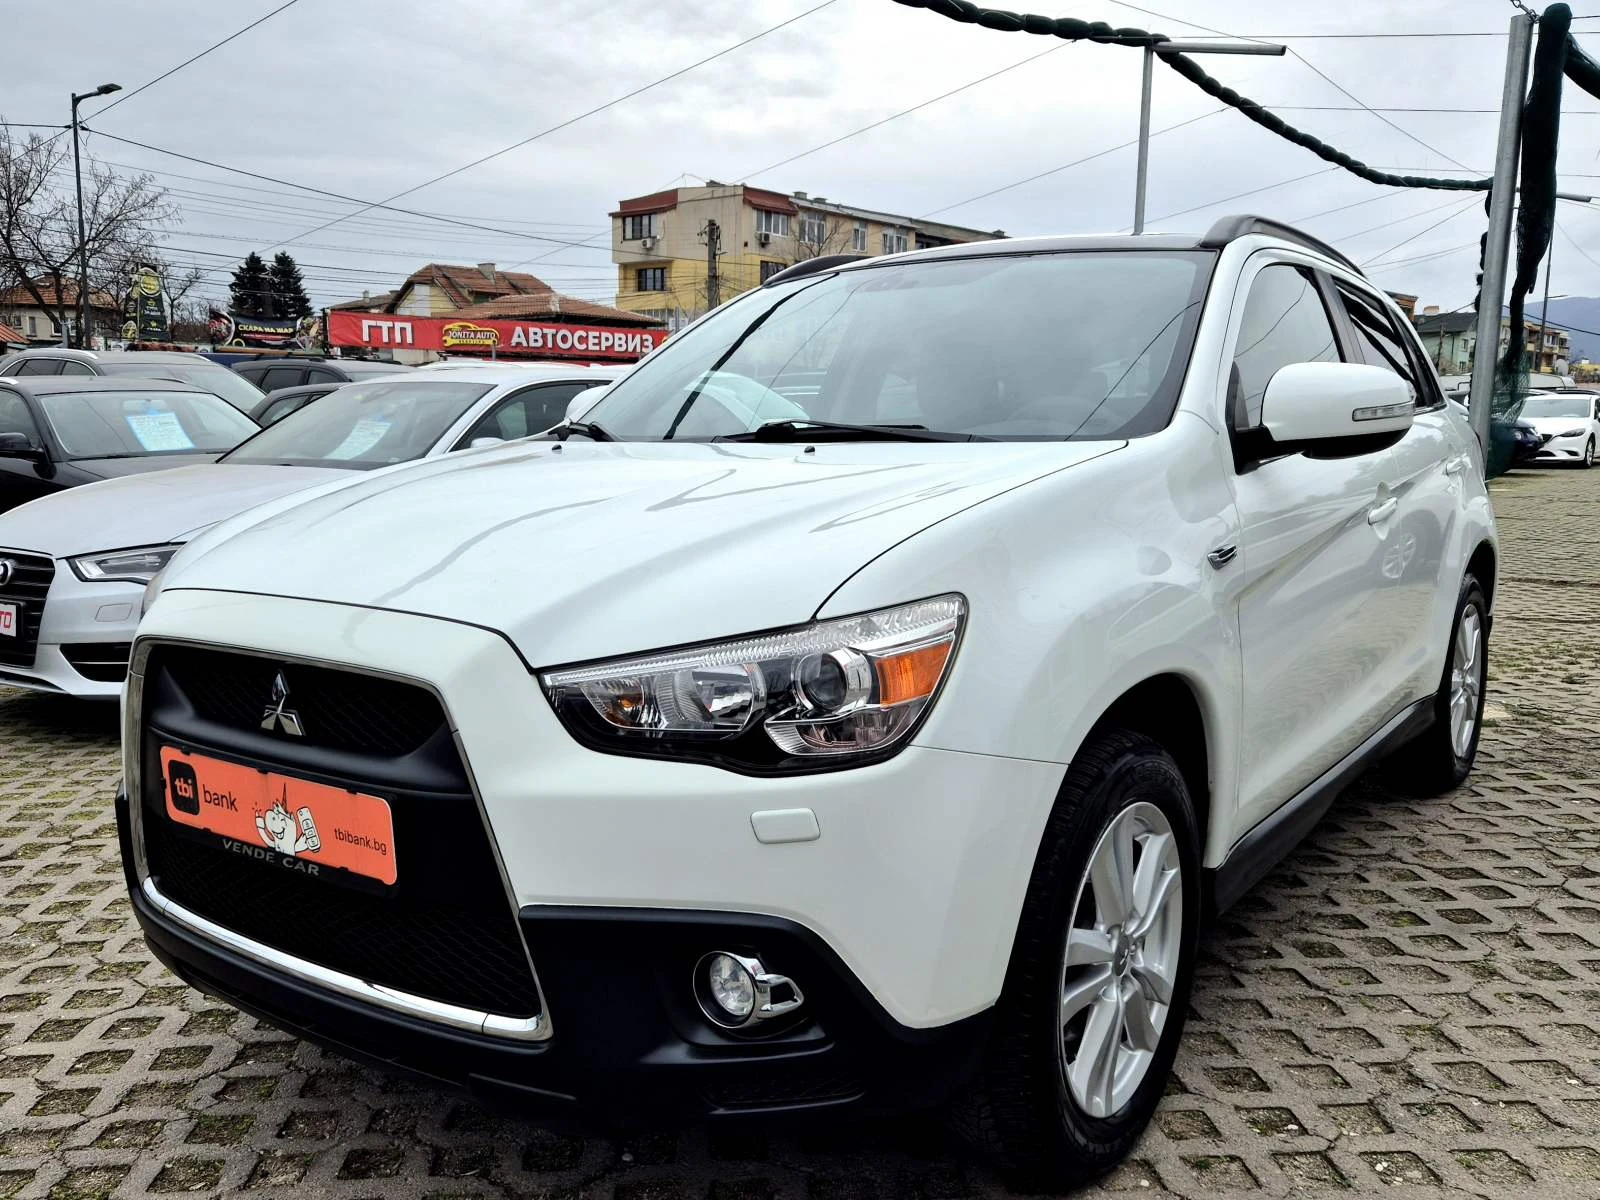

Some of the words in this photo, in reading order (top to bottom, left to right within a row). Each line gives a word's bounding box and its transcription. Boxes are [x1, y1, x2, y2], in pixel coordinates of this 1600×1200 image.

[361, 319, 413, 344] ГТП
[476, 331, 496, 339] AUTO
[510, 326, 655, 353] АВТОСЕРВИЗ
[174, 777, 194, 799] tbi
[202, 784, 238, 812] bank
[334, 827, 388, 855] tbibank.bg
[222, 838, 275, 864] VENDE
[282, 857, 320, 876] CAR
